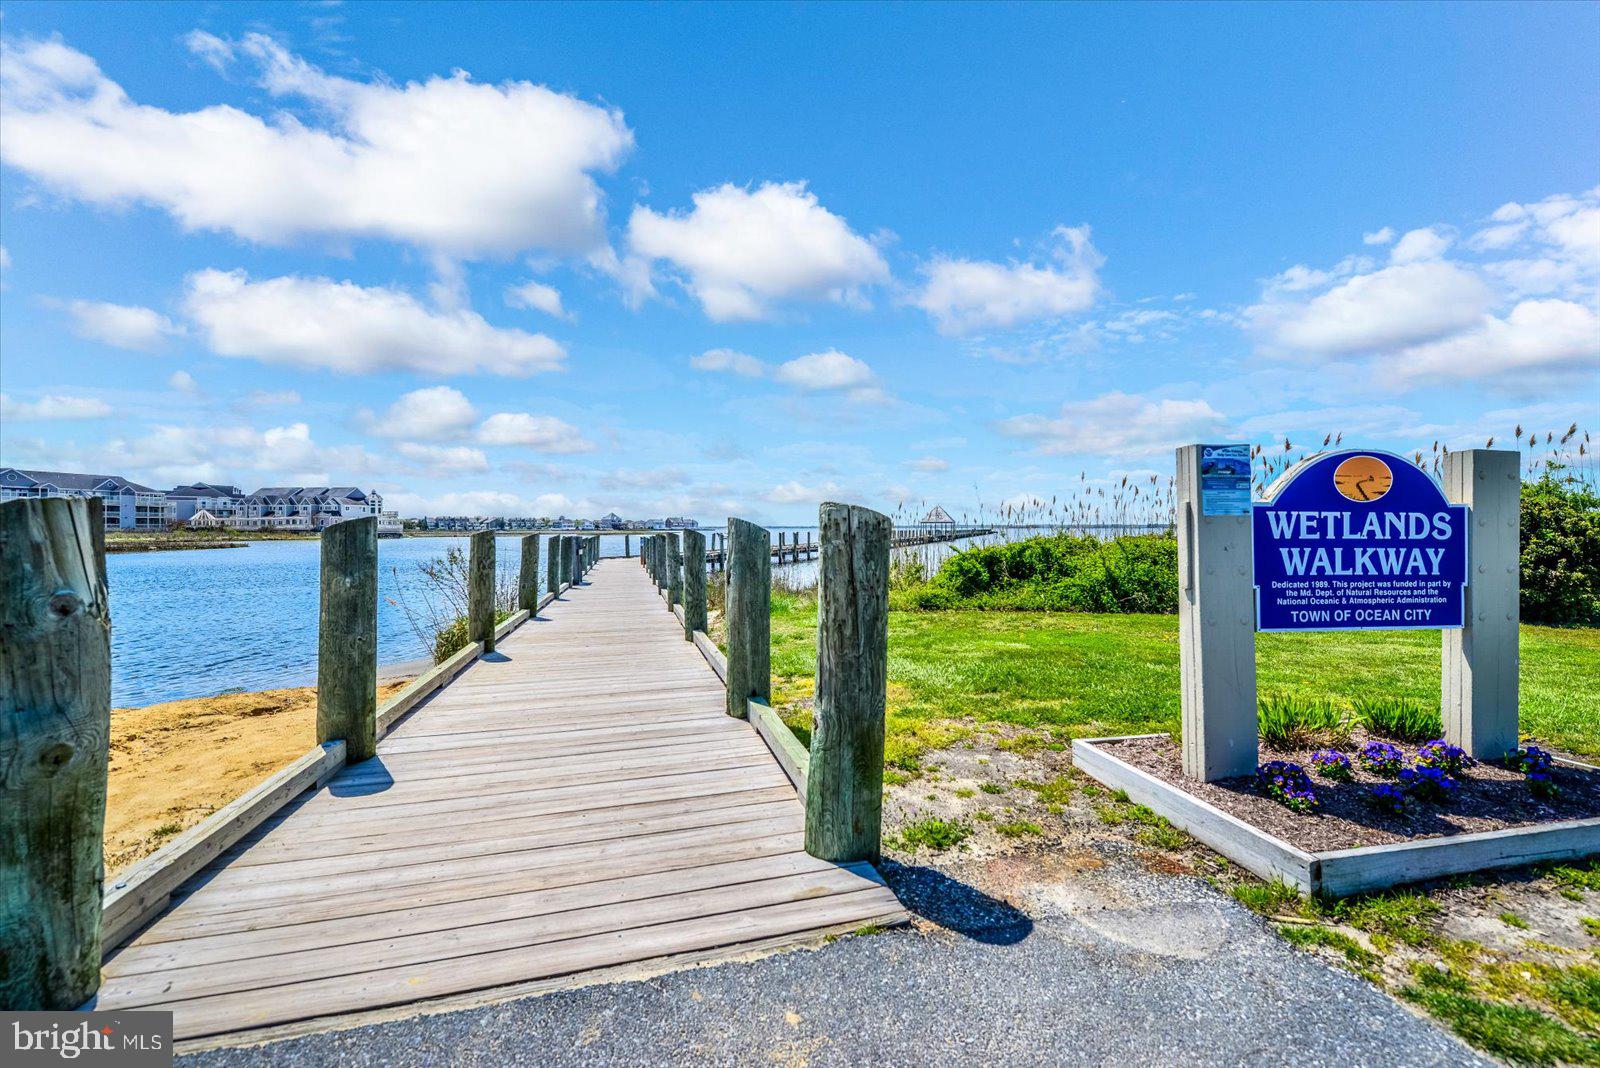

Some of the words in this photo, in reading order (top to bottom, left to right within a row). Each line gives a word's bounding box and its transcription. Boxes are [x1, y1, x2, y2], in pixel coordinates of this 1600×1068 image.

[1266, 511, 1452, 540] WETLANDS
[1279, 547, 1445, 576] WALKWAY
[1272, 581, 1309, 589] Dedicated
[1350, 581, 1375, 590] project
[1392, 580, 1417, 588] funded
[1427, 581, 1441, 589] part
[1442, 580, 1451, 589] by
[1286, 589, 1298, 597] the
[1300, 589, 1313, 597] Md.
[1315, 589, 1334, 598] Dept.
[1277, 597, 1308, 605] National
[1310, 597, 1340, 605] Oceanic
[1342, 597, 1347, 605] &
[1349, 597, 1395, 605] Atmospheric
[1396, 596, 1447, 604] Administration
[1291, 610, 1330, 622] TOWN
[1333, 610, 1351, 621] OF
[1355, 610, 1400, 621] OCEAN
[1404, 609, 1432, 620] CITY
